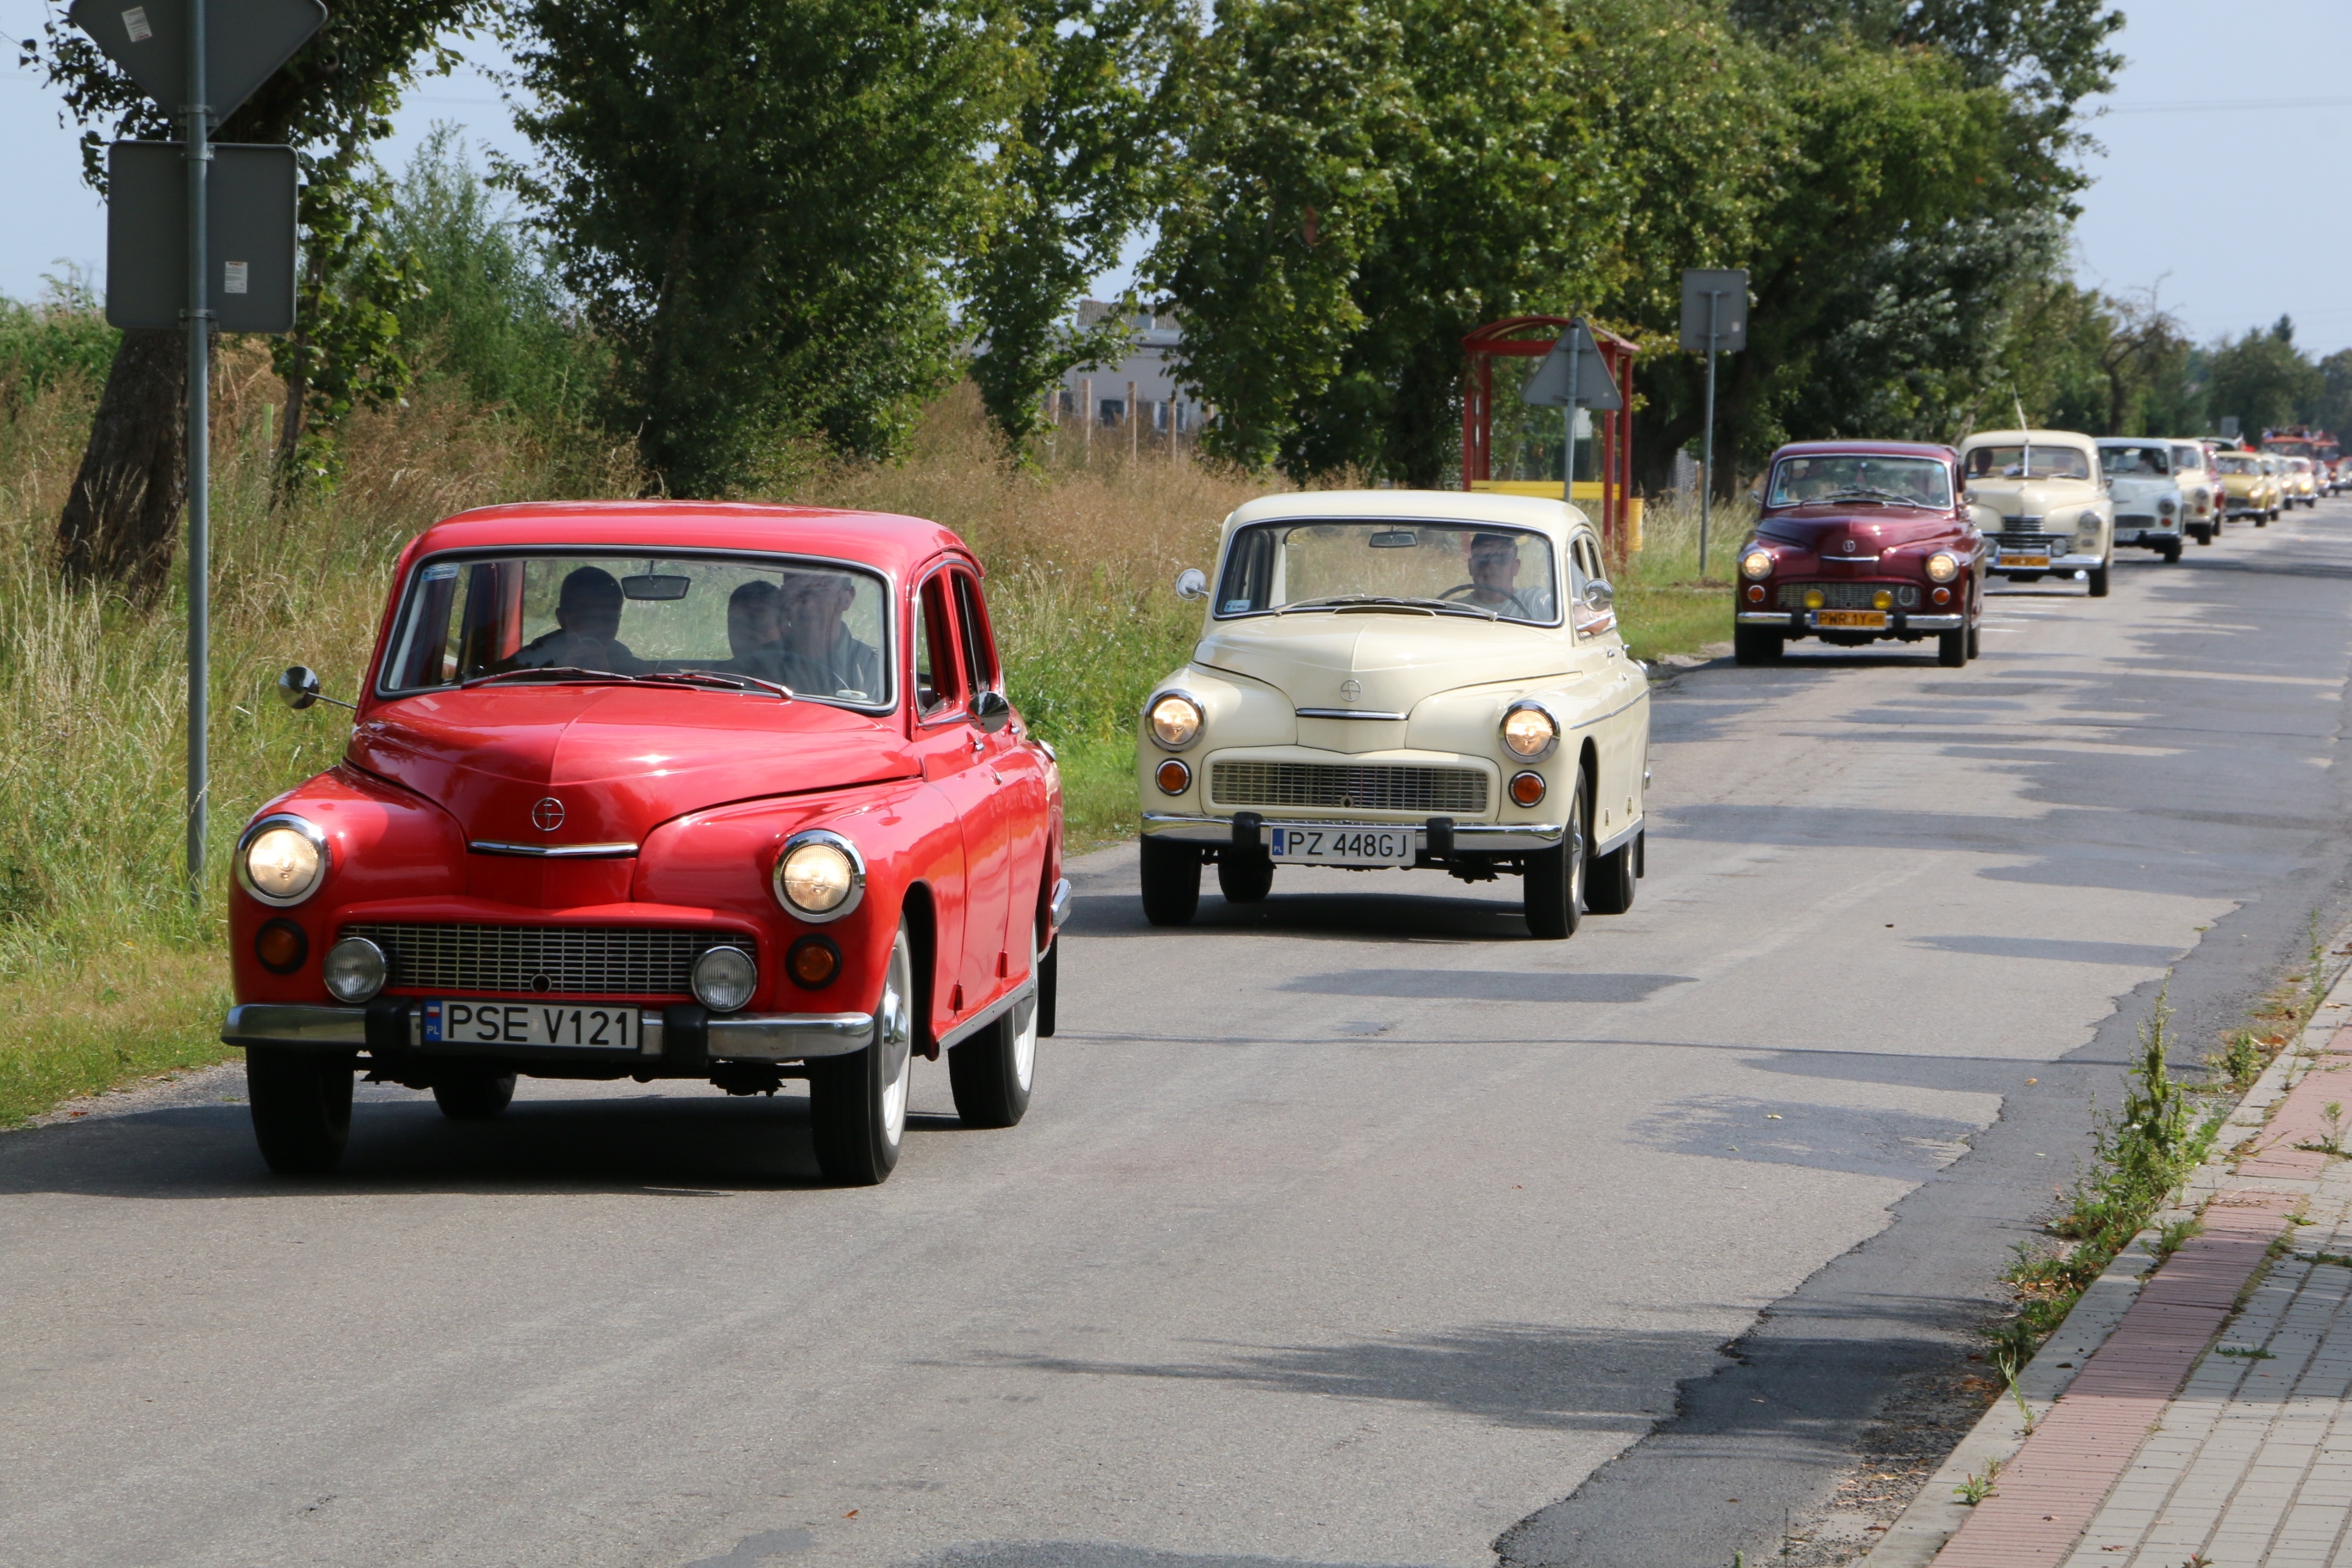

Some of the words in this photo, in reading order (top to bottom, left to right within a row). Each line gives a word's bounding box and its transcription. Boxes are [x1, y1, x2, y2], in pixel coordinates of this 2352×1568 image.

[1819, 612, 1847, 625] PWR
[1853, 613, 1867, 626] 1Y
[1289, 831, 1323, 855] PZ
[1332, 833, 1406, 858] 448GJ
[426, 1025, 439, 1035] PL
[448, 1004, 529, 1042] PSE
[543, 1008, 628, 1045] V121
